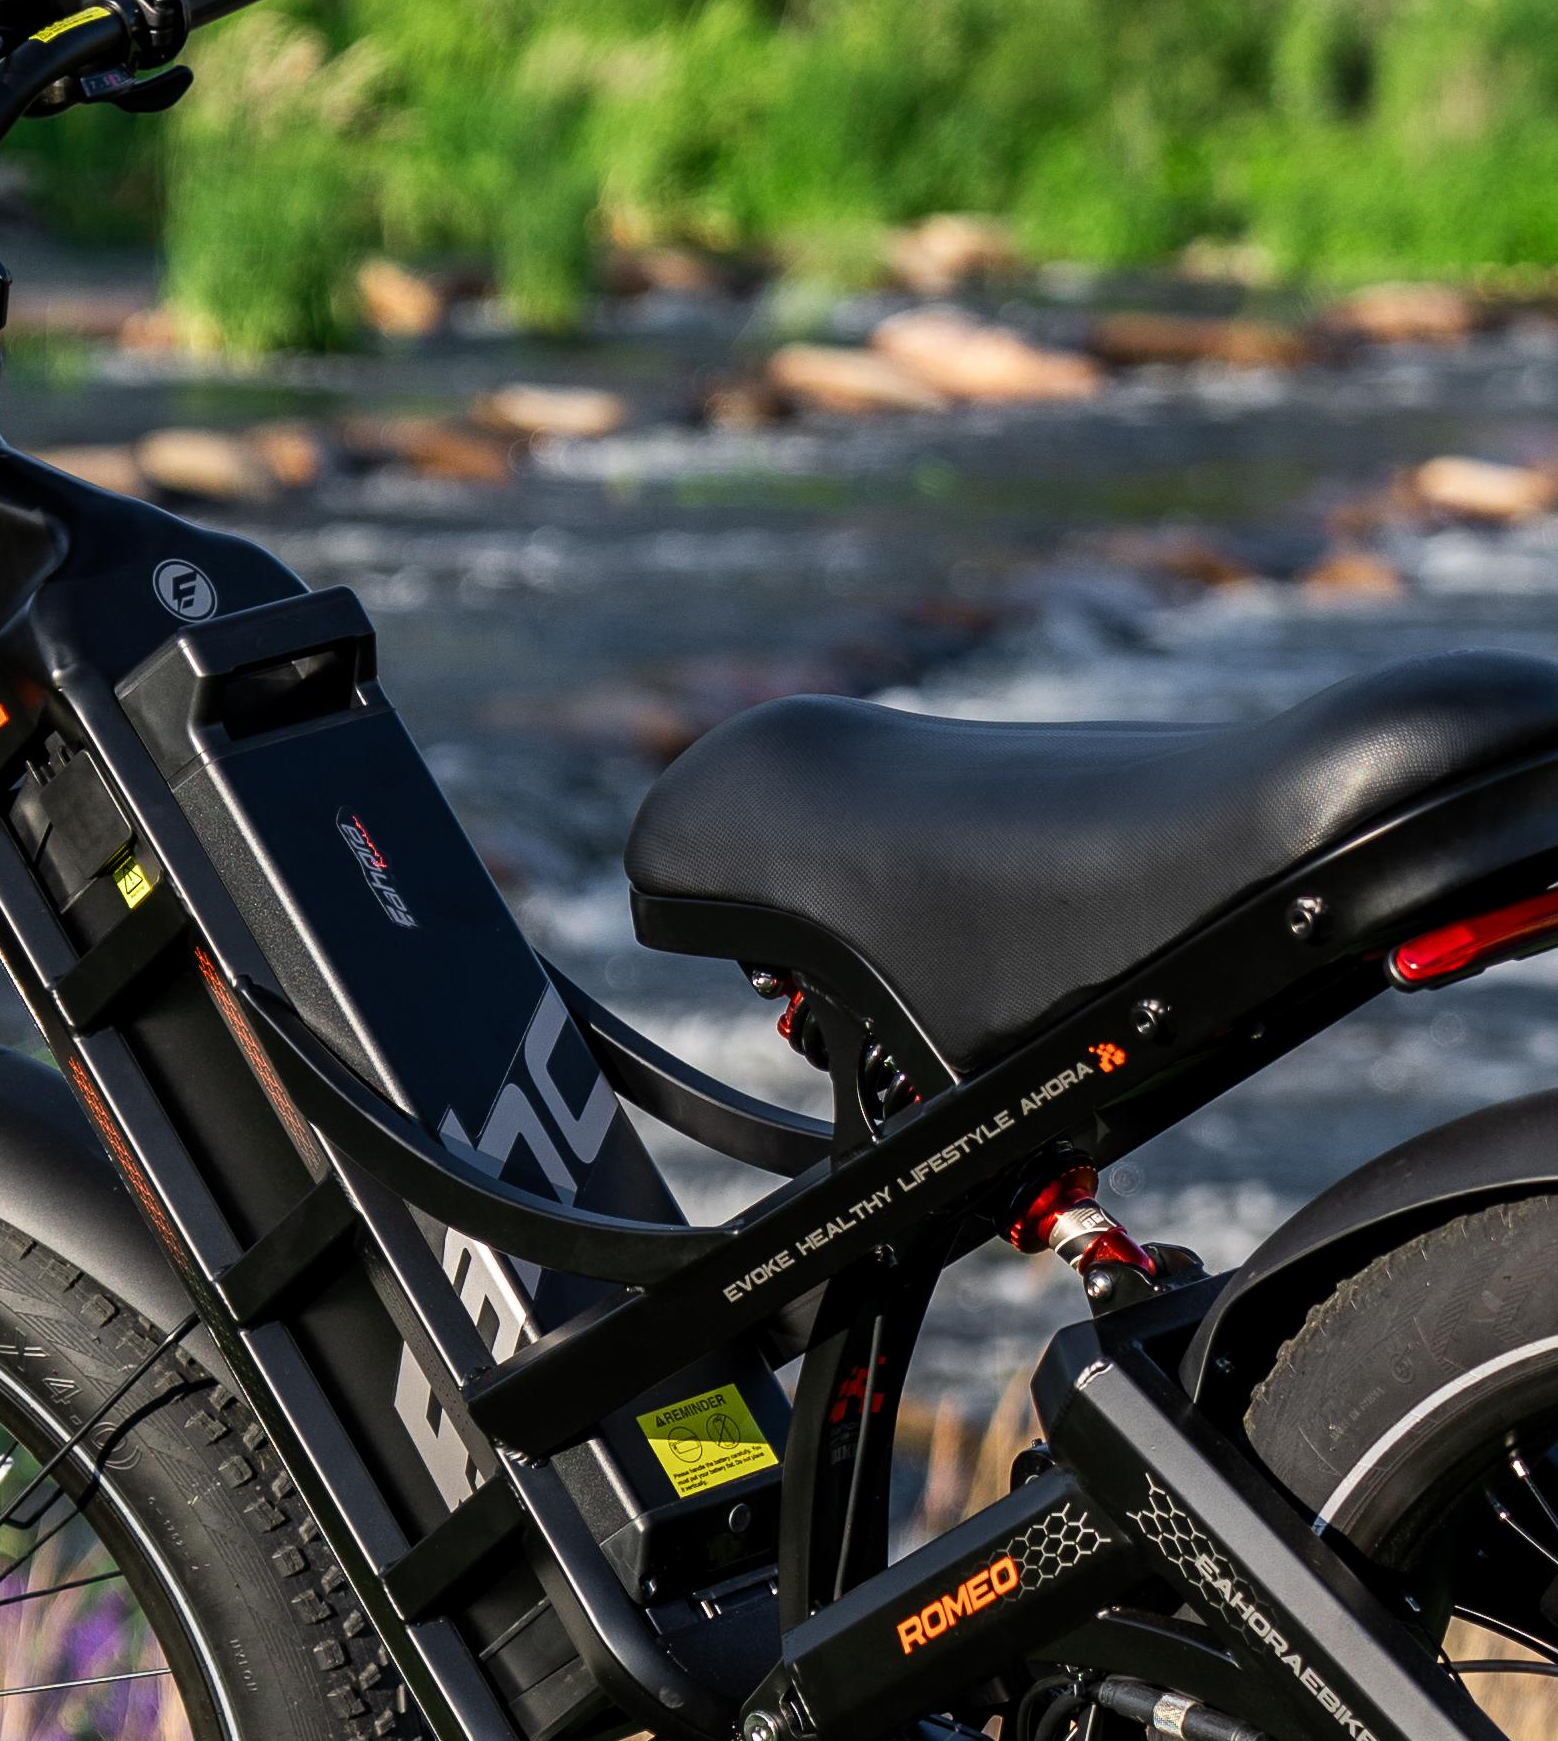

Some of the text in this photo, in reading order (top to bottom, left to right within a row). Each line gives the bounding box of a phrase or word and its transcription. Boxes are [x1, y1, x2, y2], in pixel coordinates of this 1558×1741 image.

[723, 1061, 1095, 1303] EVOKE HEALTHY LIFESTYLE AHORA
[665, 1393, 727, 1424] REMINDER
[673, 1469, 690, 1480] Please
[689, 1463, 706, 1476] handle
[713, 1456, 731, 1468] battery
[709, 1464, 727, 1478] battery
[896, 1556, 1019, 1655] ROMEO
